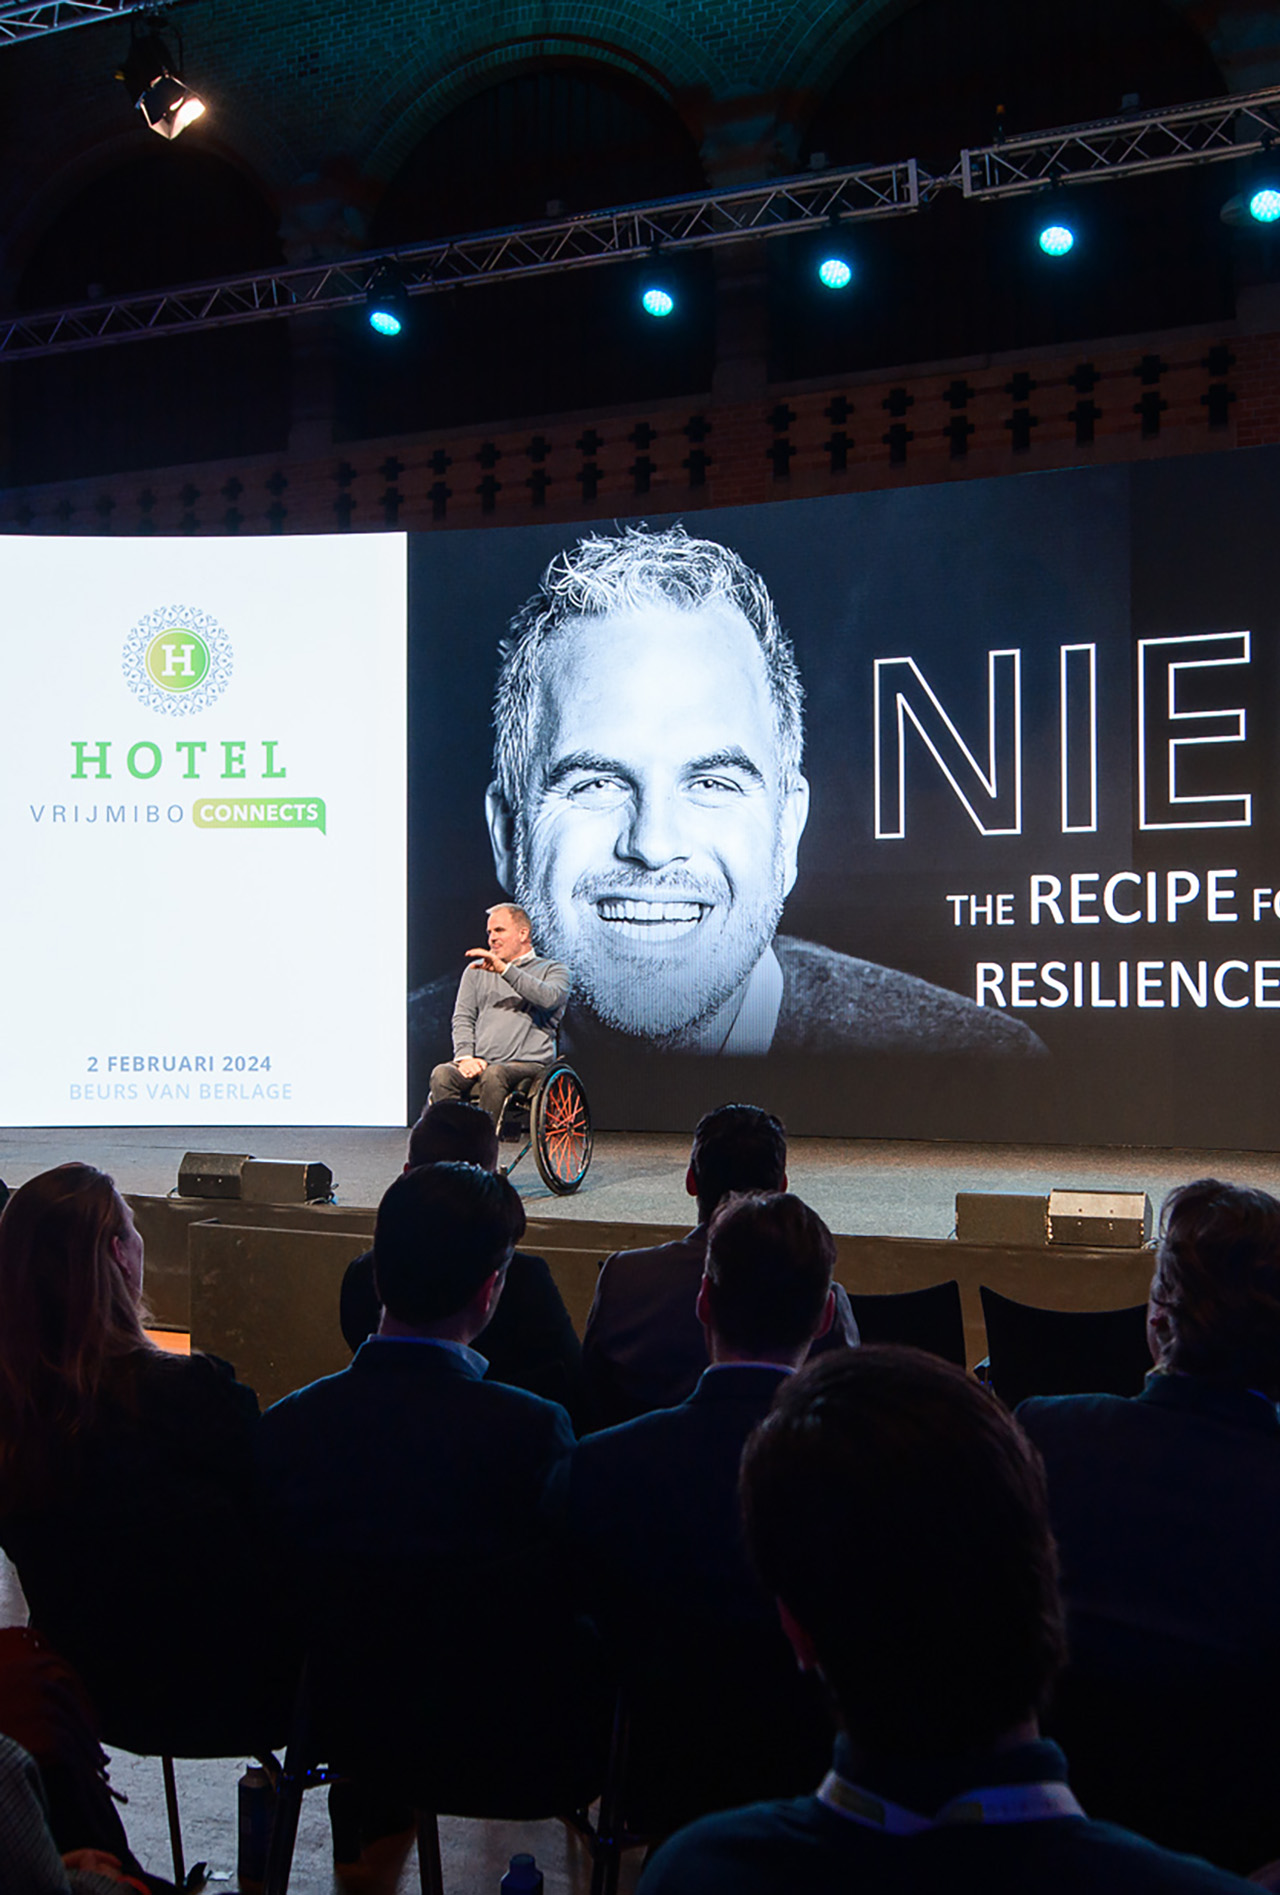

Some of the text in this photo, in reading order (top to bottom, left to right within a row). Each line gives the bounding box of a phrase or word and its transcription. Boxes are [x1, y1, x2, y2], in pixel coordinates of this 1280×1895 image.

[70, 740, 287, 780] HOTEL
[29, 803, 319, 823] VRIJMIBO CONNECTS
[946, 893, 1015, 926] THE
[1029, 868, 1239, 926] RECIPE
[87, 1055, 272, 1072] 2 FEBRUARI 2024
[69, 1083, 293, 1101] BEURS VAN BERLAGE
